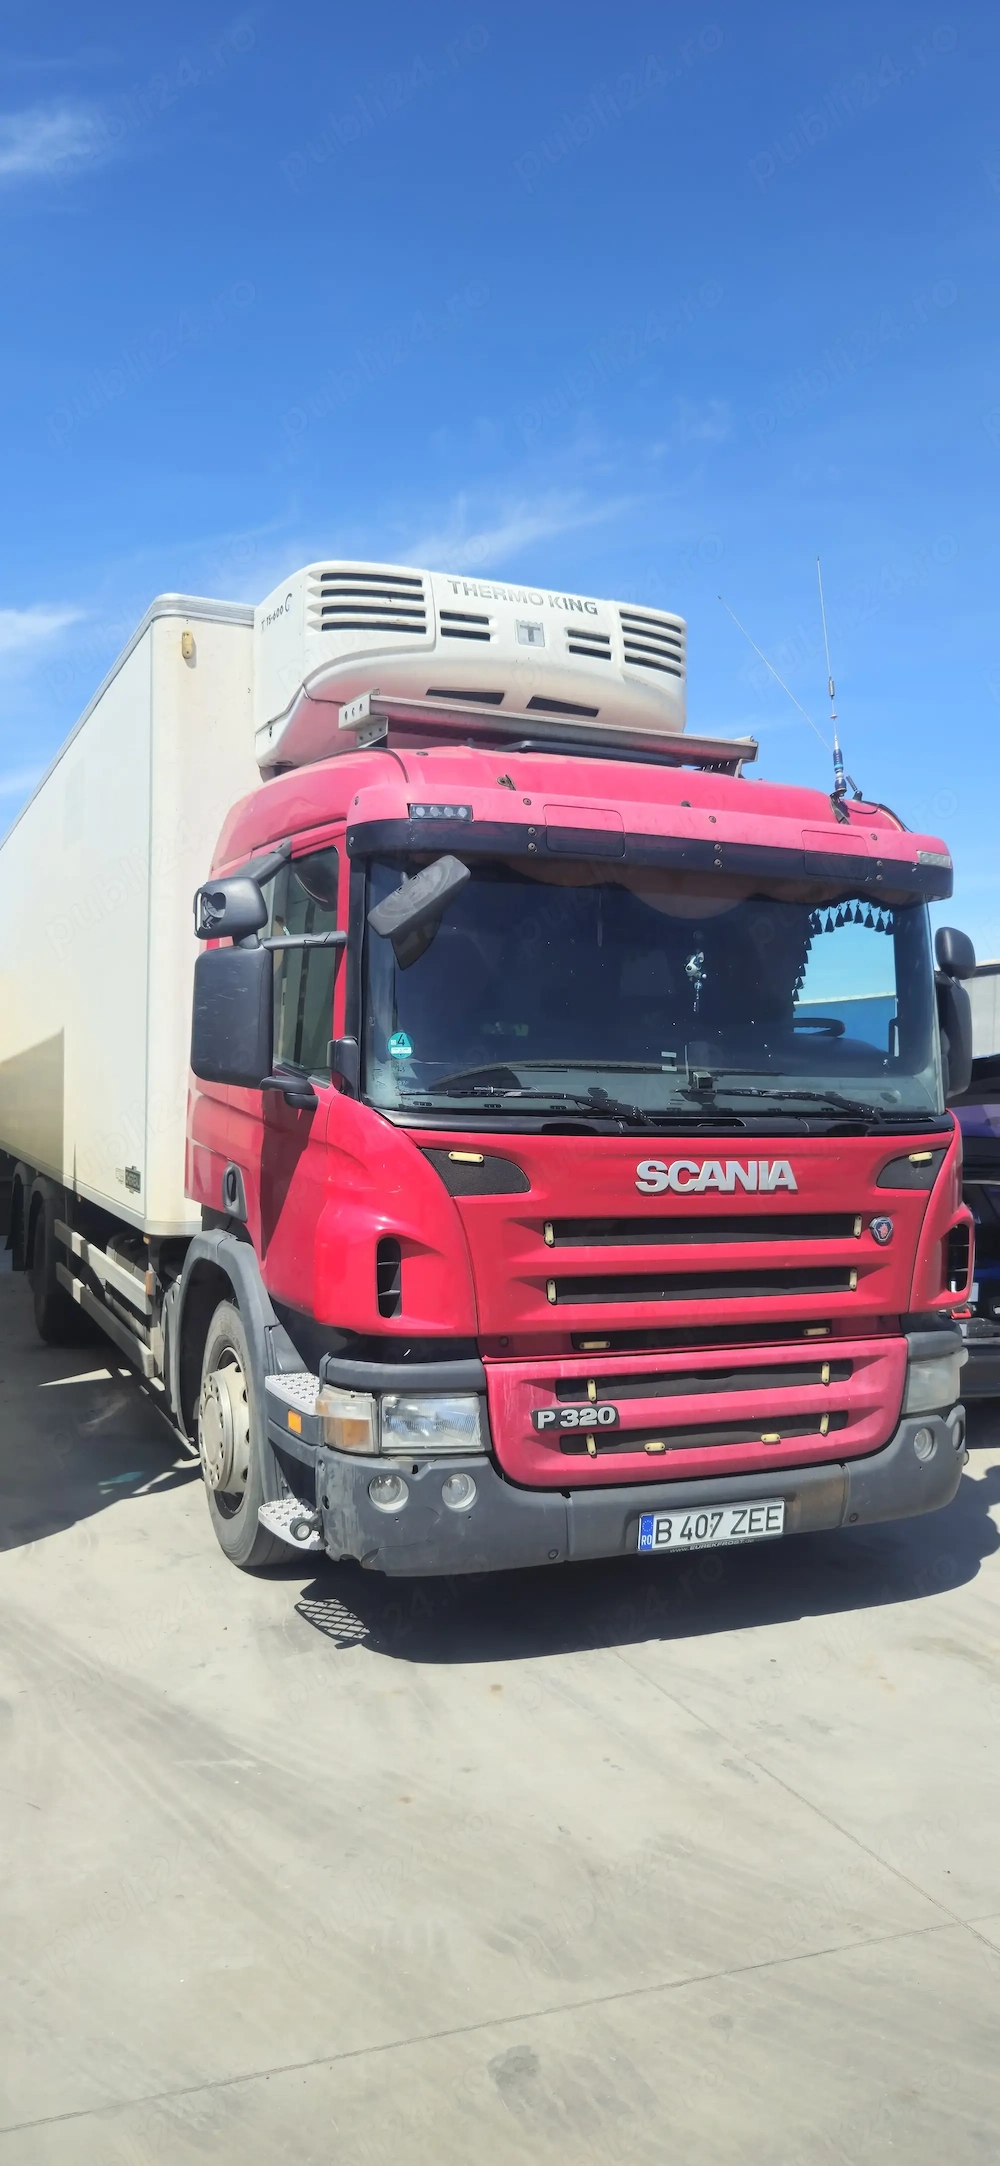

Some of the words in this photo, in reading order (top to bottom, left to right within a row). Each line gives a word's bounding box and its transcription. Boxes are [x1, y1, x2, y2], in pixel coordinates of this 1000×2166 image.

[447, 579, 544, 606] THERMO
[549, 594, 599, 616] KING
[397, 1033, 406, 1046] 4
[635, 1160, 798, 1195] SCANIA
[537, 1411, 556, 1430] P
[560, 1406, 616, 1428] 320
[641, 1534, 652, 1546] RO
[655, 1518, 673, 1544] B
[680, 1512, 724, 1541] 407
[730, 1505, 782, 1535] ZEE
